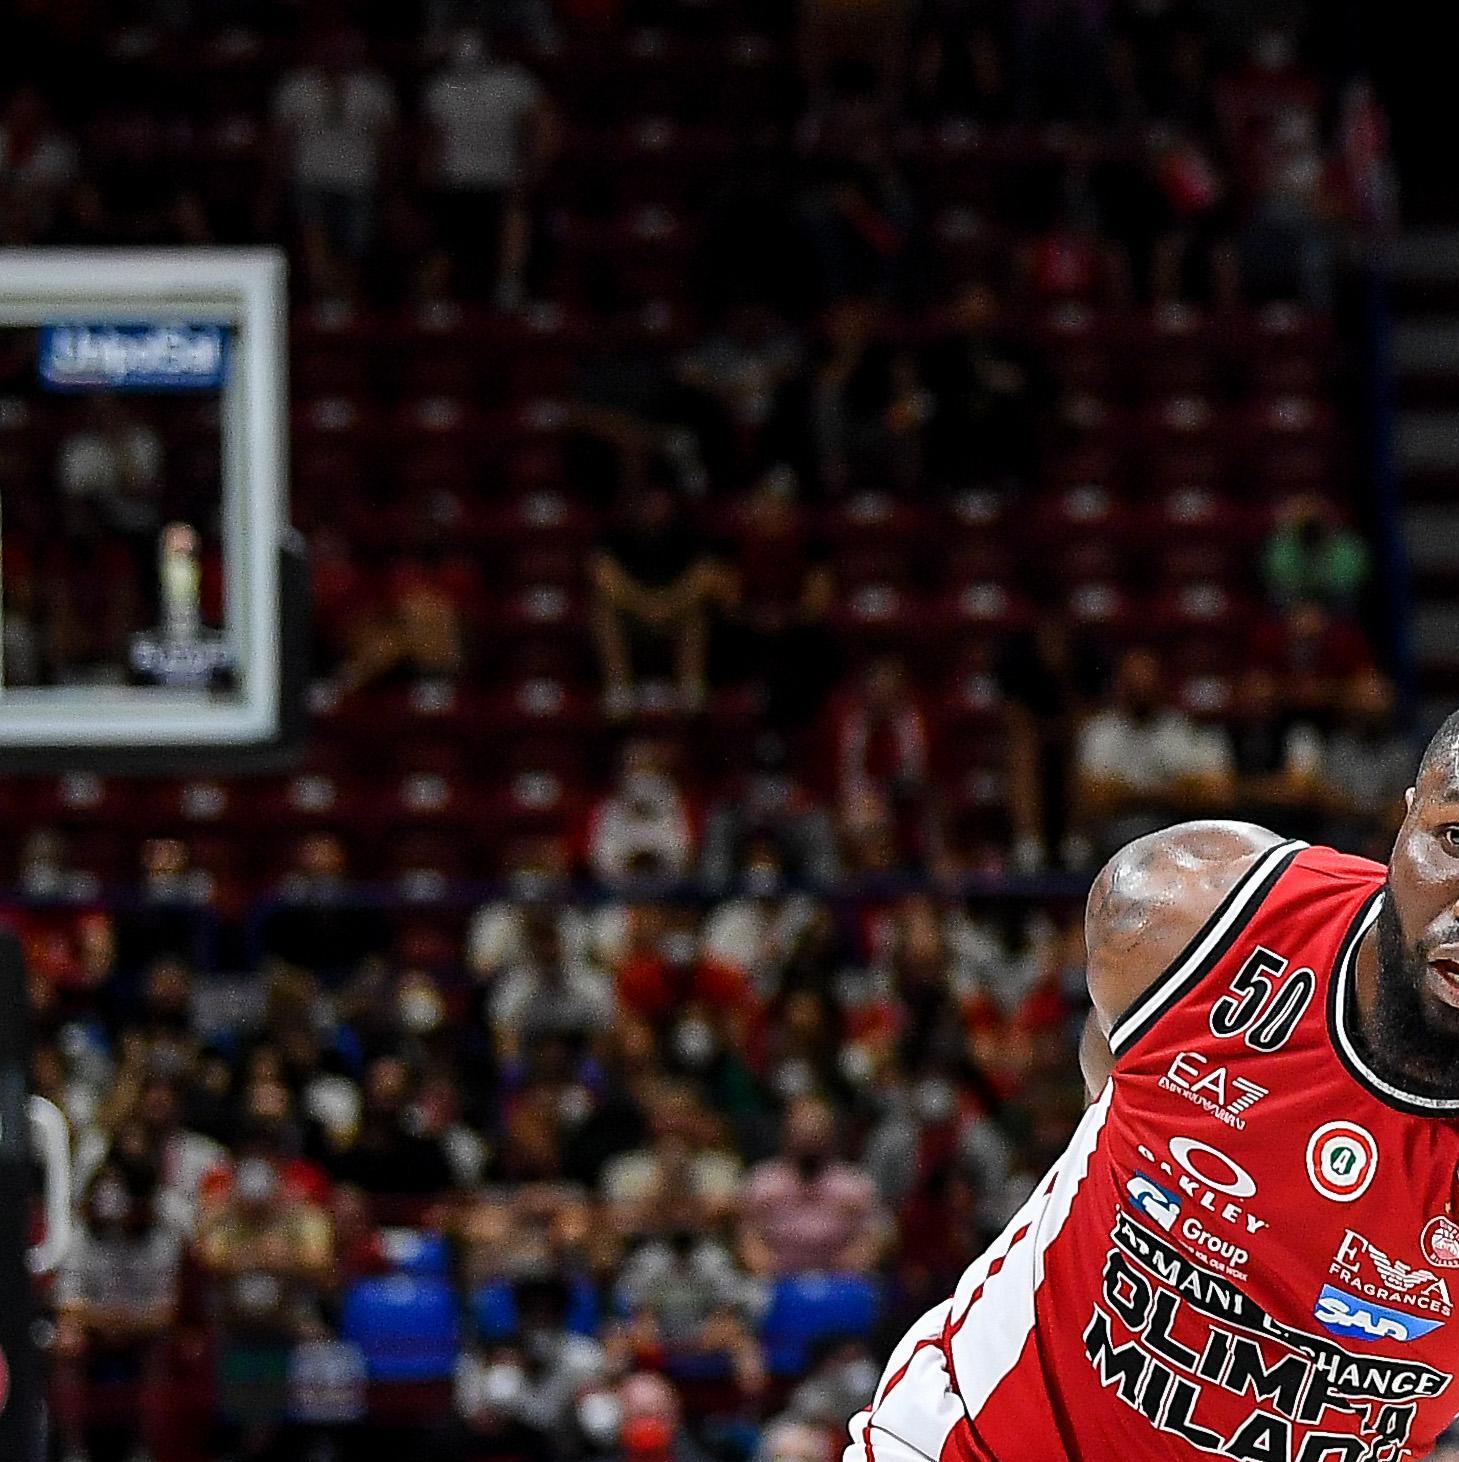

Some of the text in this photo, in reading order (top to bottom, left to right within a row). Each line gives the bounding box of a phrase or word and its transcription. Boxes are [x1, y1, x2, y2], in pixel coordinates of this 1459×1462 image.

[1209, 944, 1316, 1053] 50
[1167, 1051, 1270, 1115] EA7
[1182, 1217, 1249, 1267] Group
[1314, 1297, 1409, 1342] SAP
[1328, 1262, 1451, 1318] FRAGRANCES
[1103, 1248, 1417, 1448] OLIMPA
